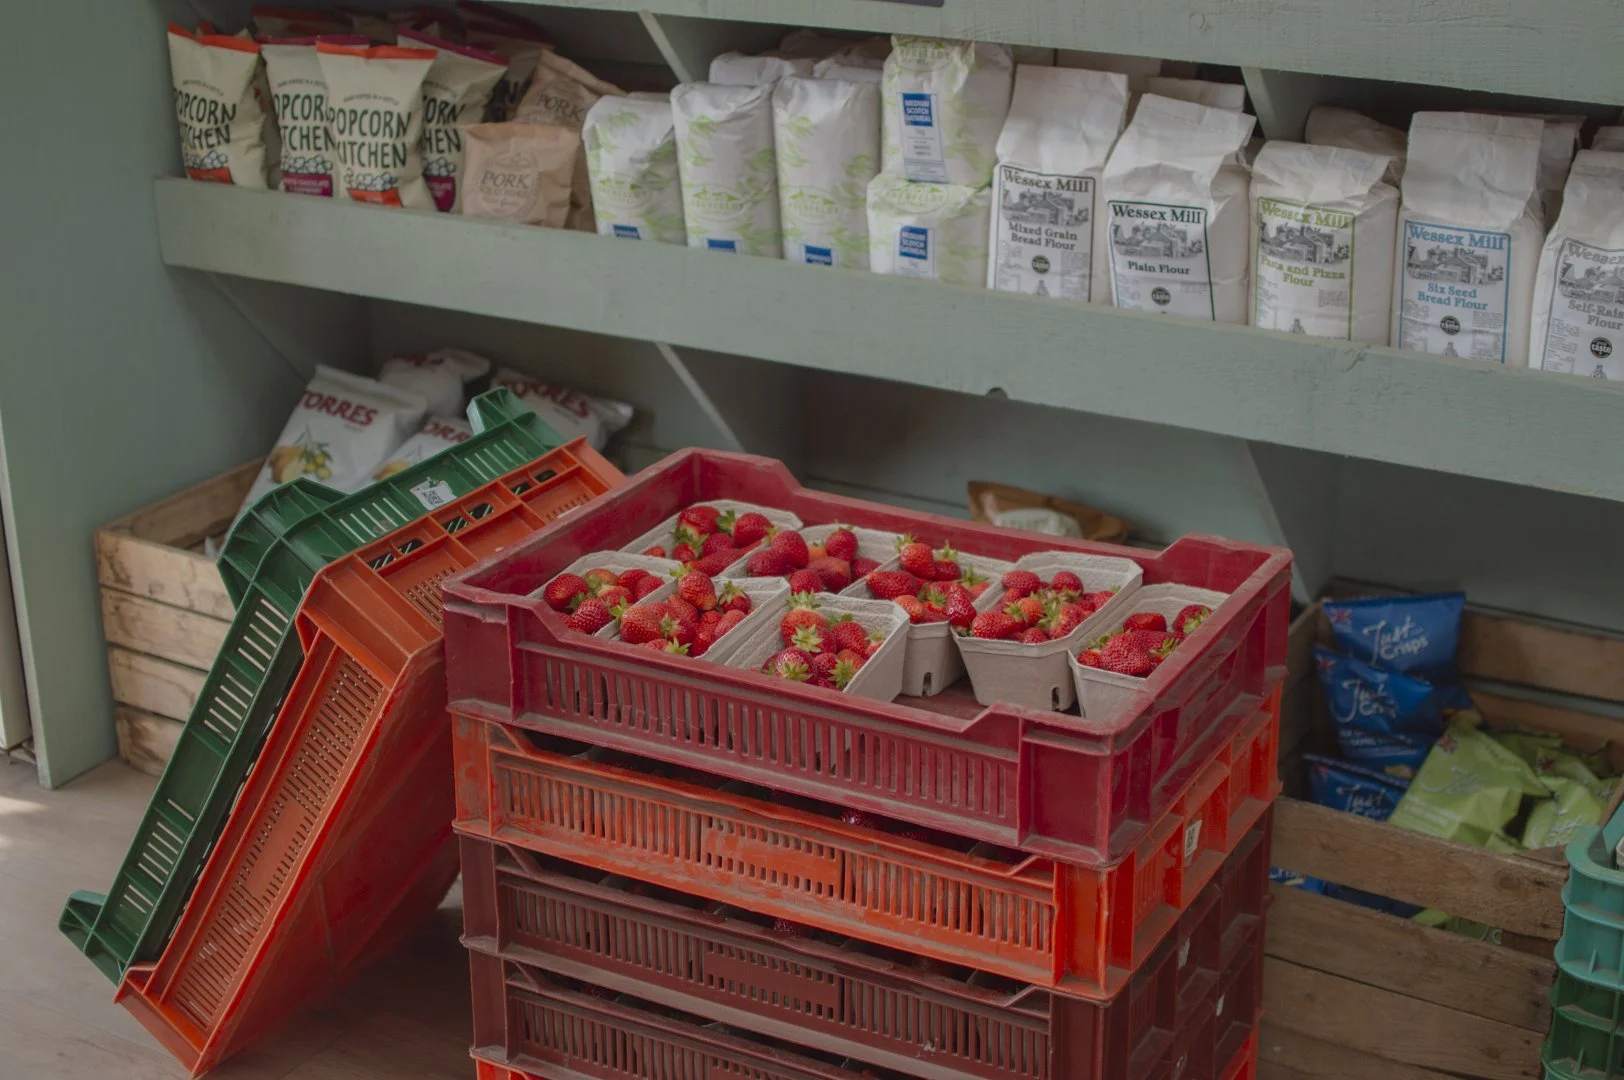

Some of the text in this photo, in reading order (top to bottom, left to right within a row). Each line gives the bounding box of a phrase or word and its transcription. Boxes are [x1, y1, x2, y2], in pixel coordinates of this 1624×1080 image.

[536, 93, 586, 123] PORK
[481, 170, 531, 190] PORK
[1003, 168, 1090, 193] Wessex Mill
[1112, 204, 1202, 225] Wessex Mill
[1261, 200, 1351, 229] Wessex Mill
[1008, 221, 1078, 241] Mixed Grain
[1408, 224, 1505, 251] Wessex Mill
[1011, 232, 1077, 251] Bread Flour
[1127, 260, 1191, 275] Plain Flour
[1287, 264, 1309, 276] and
[1312, 266, 1346, 280] Pizza
[1283, 272, 1315, 287] Flour
[1427, 282, 1478, 299] Six Seed
[1417, 291, 1489, 311] Bread Flour
[1586, 314, 1624, 331] Flour
[1361, 614, 1416, 666] Just
[1379, 635, 1430, 661] Crisps
